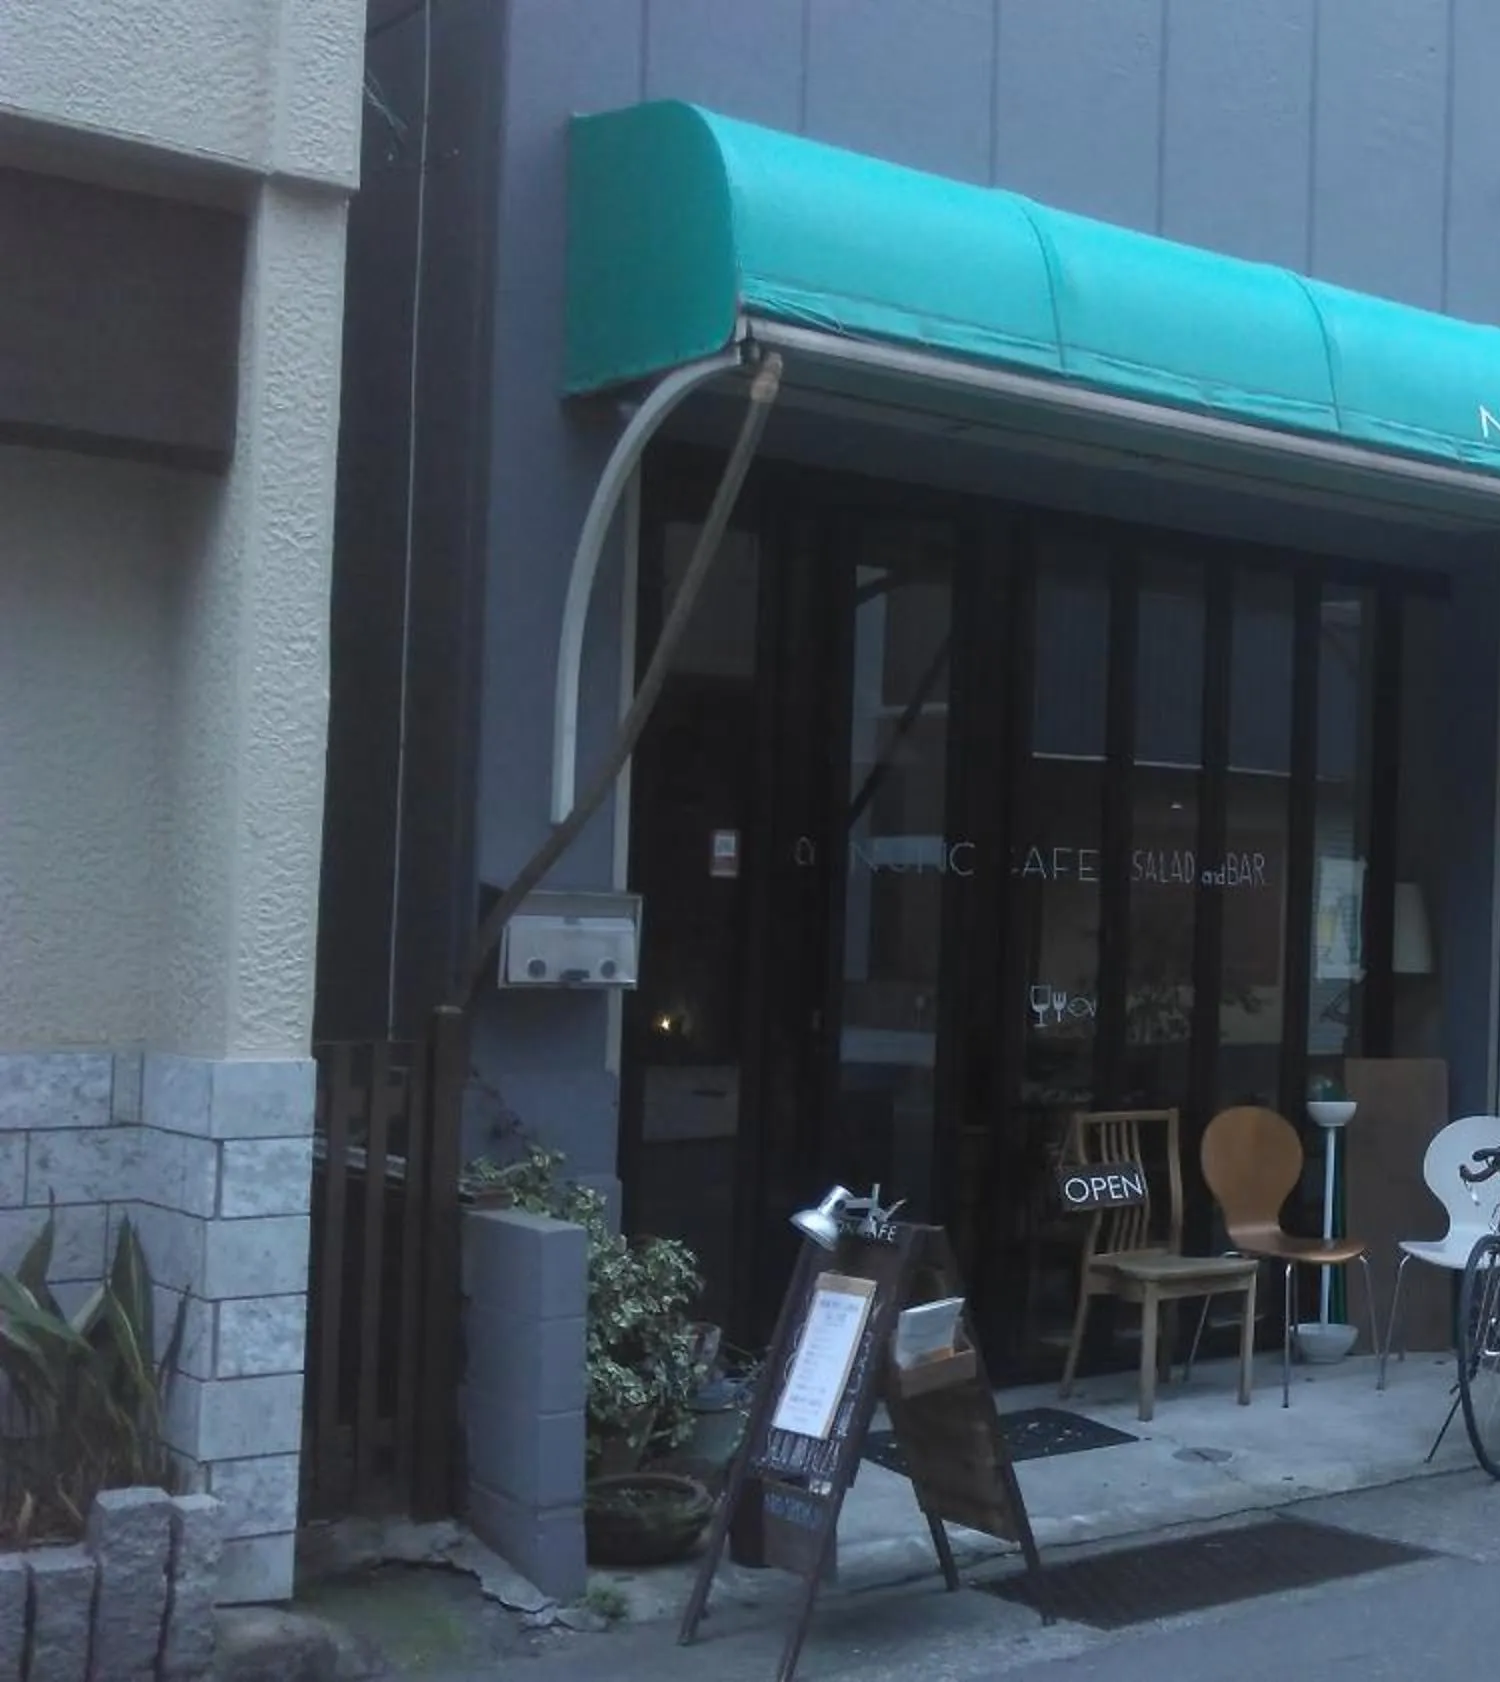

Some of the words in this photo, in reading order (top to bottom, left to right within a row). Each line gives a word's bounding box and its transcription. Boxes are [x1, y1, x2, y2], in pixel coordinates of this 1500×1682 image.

[1131, 848, 1196, 884] SALAD
[1227, 851, 1266, 887] BAR
[1064, 1174, 1142, 1203] OPEN
